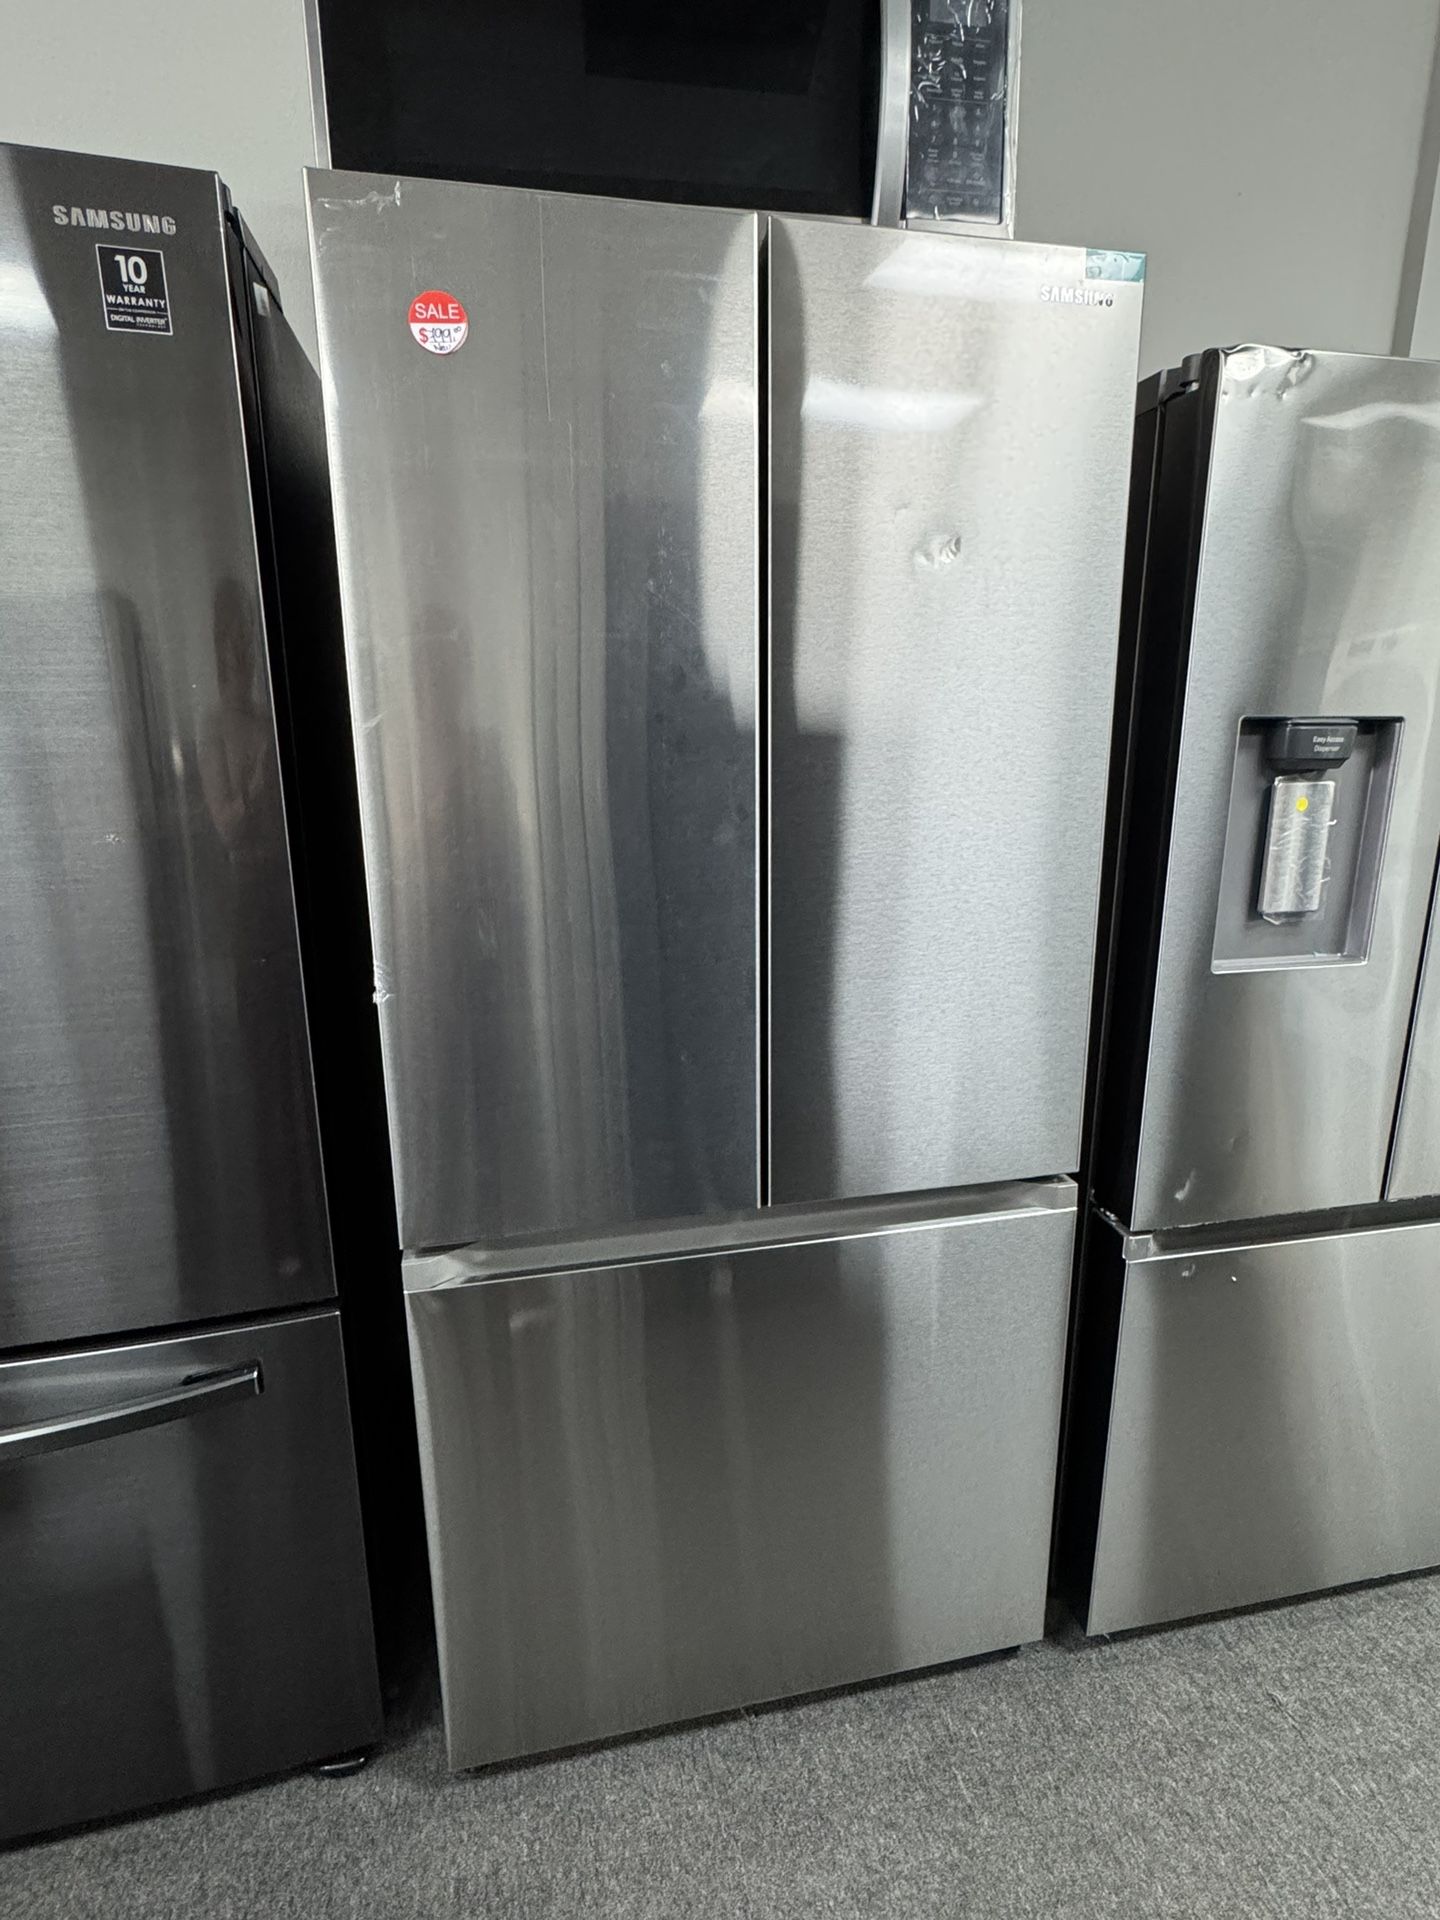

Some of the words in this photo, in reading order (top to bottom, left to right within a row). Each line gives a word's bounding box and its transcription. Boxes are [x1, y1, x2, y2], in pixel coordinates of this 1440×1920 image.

[52, 204, 177, 236] SAMSUNG
[114, 254, 148, 284] 10
[122, 283, 146, 294] YEAR
[106, 293, 166, 309] WARRANTY
[110, 313, 136, 324] DIGITAL
[414, 302, 461, 320] SALE
